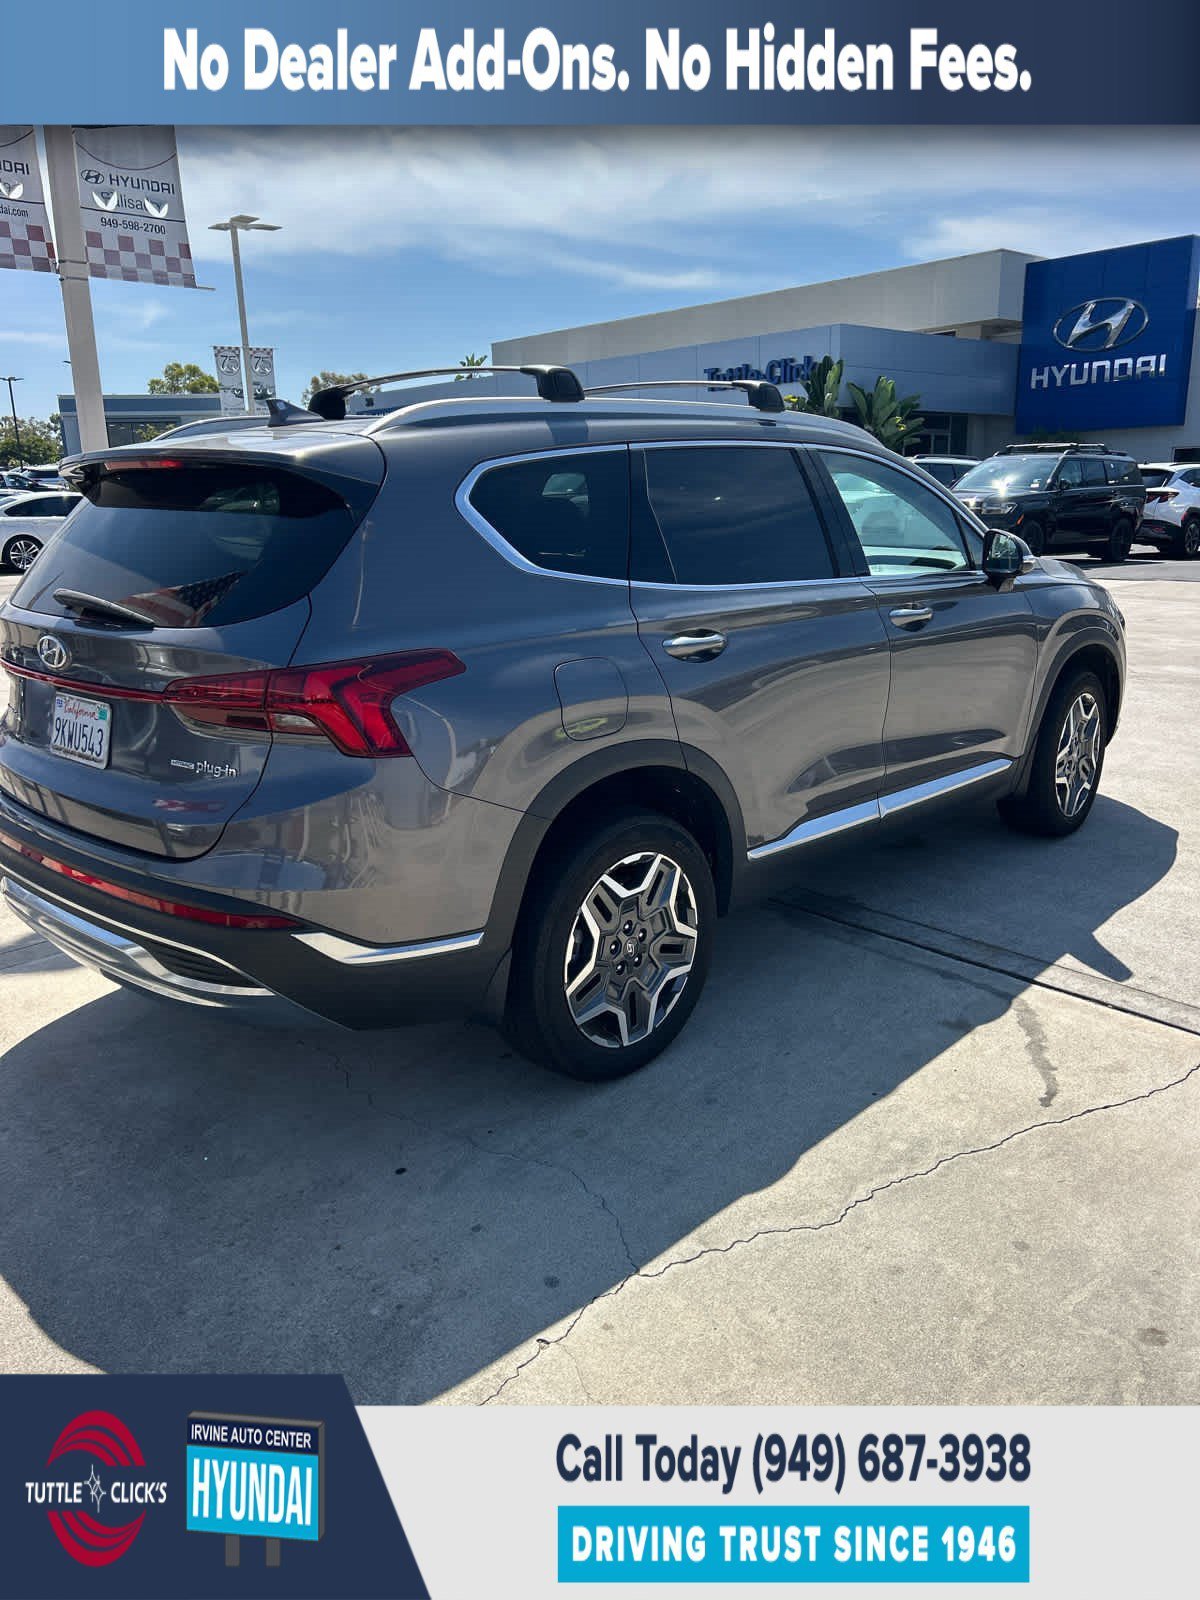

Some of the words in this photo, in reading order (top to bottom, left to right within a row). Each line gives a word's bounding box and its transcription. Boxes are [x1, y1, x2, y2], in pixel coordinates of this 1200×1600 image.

[0, 159, 30, 175] DAI
[109, 173, 175, 195] HYUNDAI
[100, 216, 167, 235] 949-598-2700
[1030, 353, 1167, 389] HYUNDAI
[64, 699, 98, 721] California
[53, 716, 104, 758] 9KWU543
[196, 760, 239, 778] plug-in
